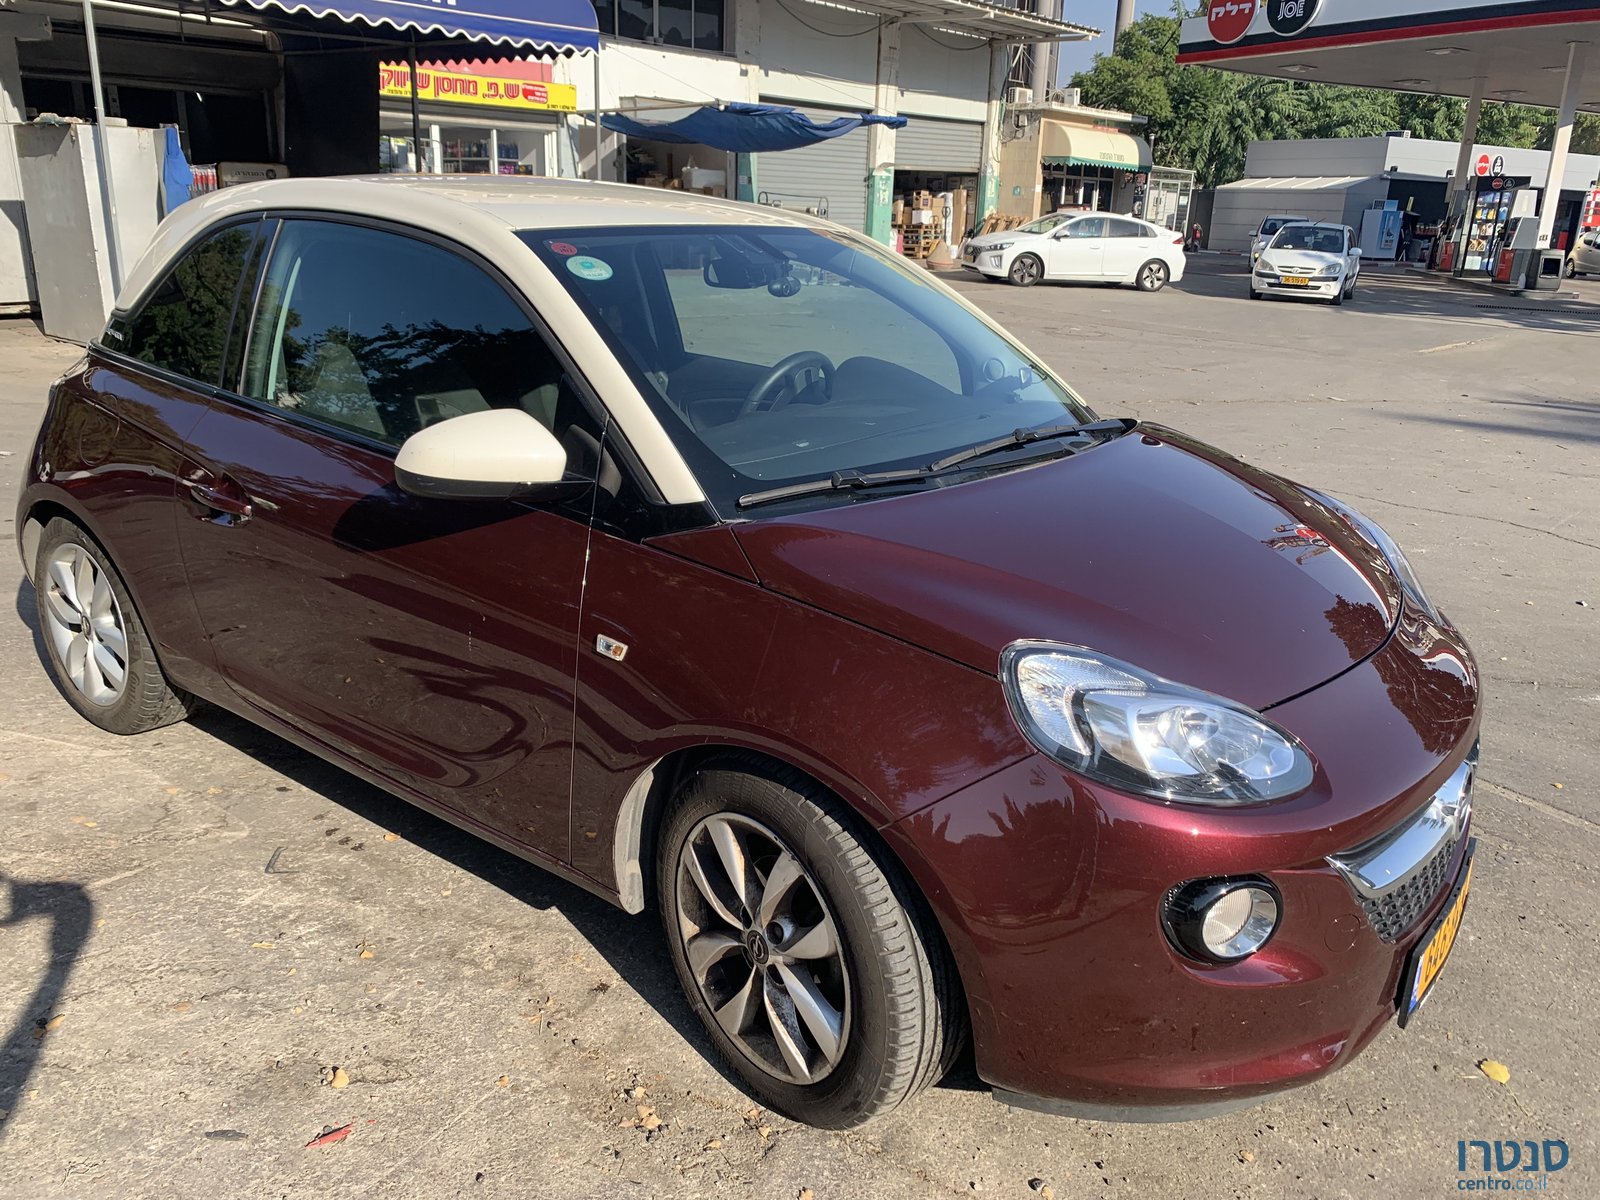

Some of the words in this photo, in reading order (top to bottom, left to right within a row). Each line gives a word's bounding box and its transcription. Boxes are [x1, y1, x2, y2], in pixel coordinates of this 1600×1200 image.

[1210, 2, 1252, 22] דלק
[1277, 0, 1305, 21] JOE
[433, 74, 478, 98] מחסן
